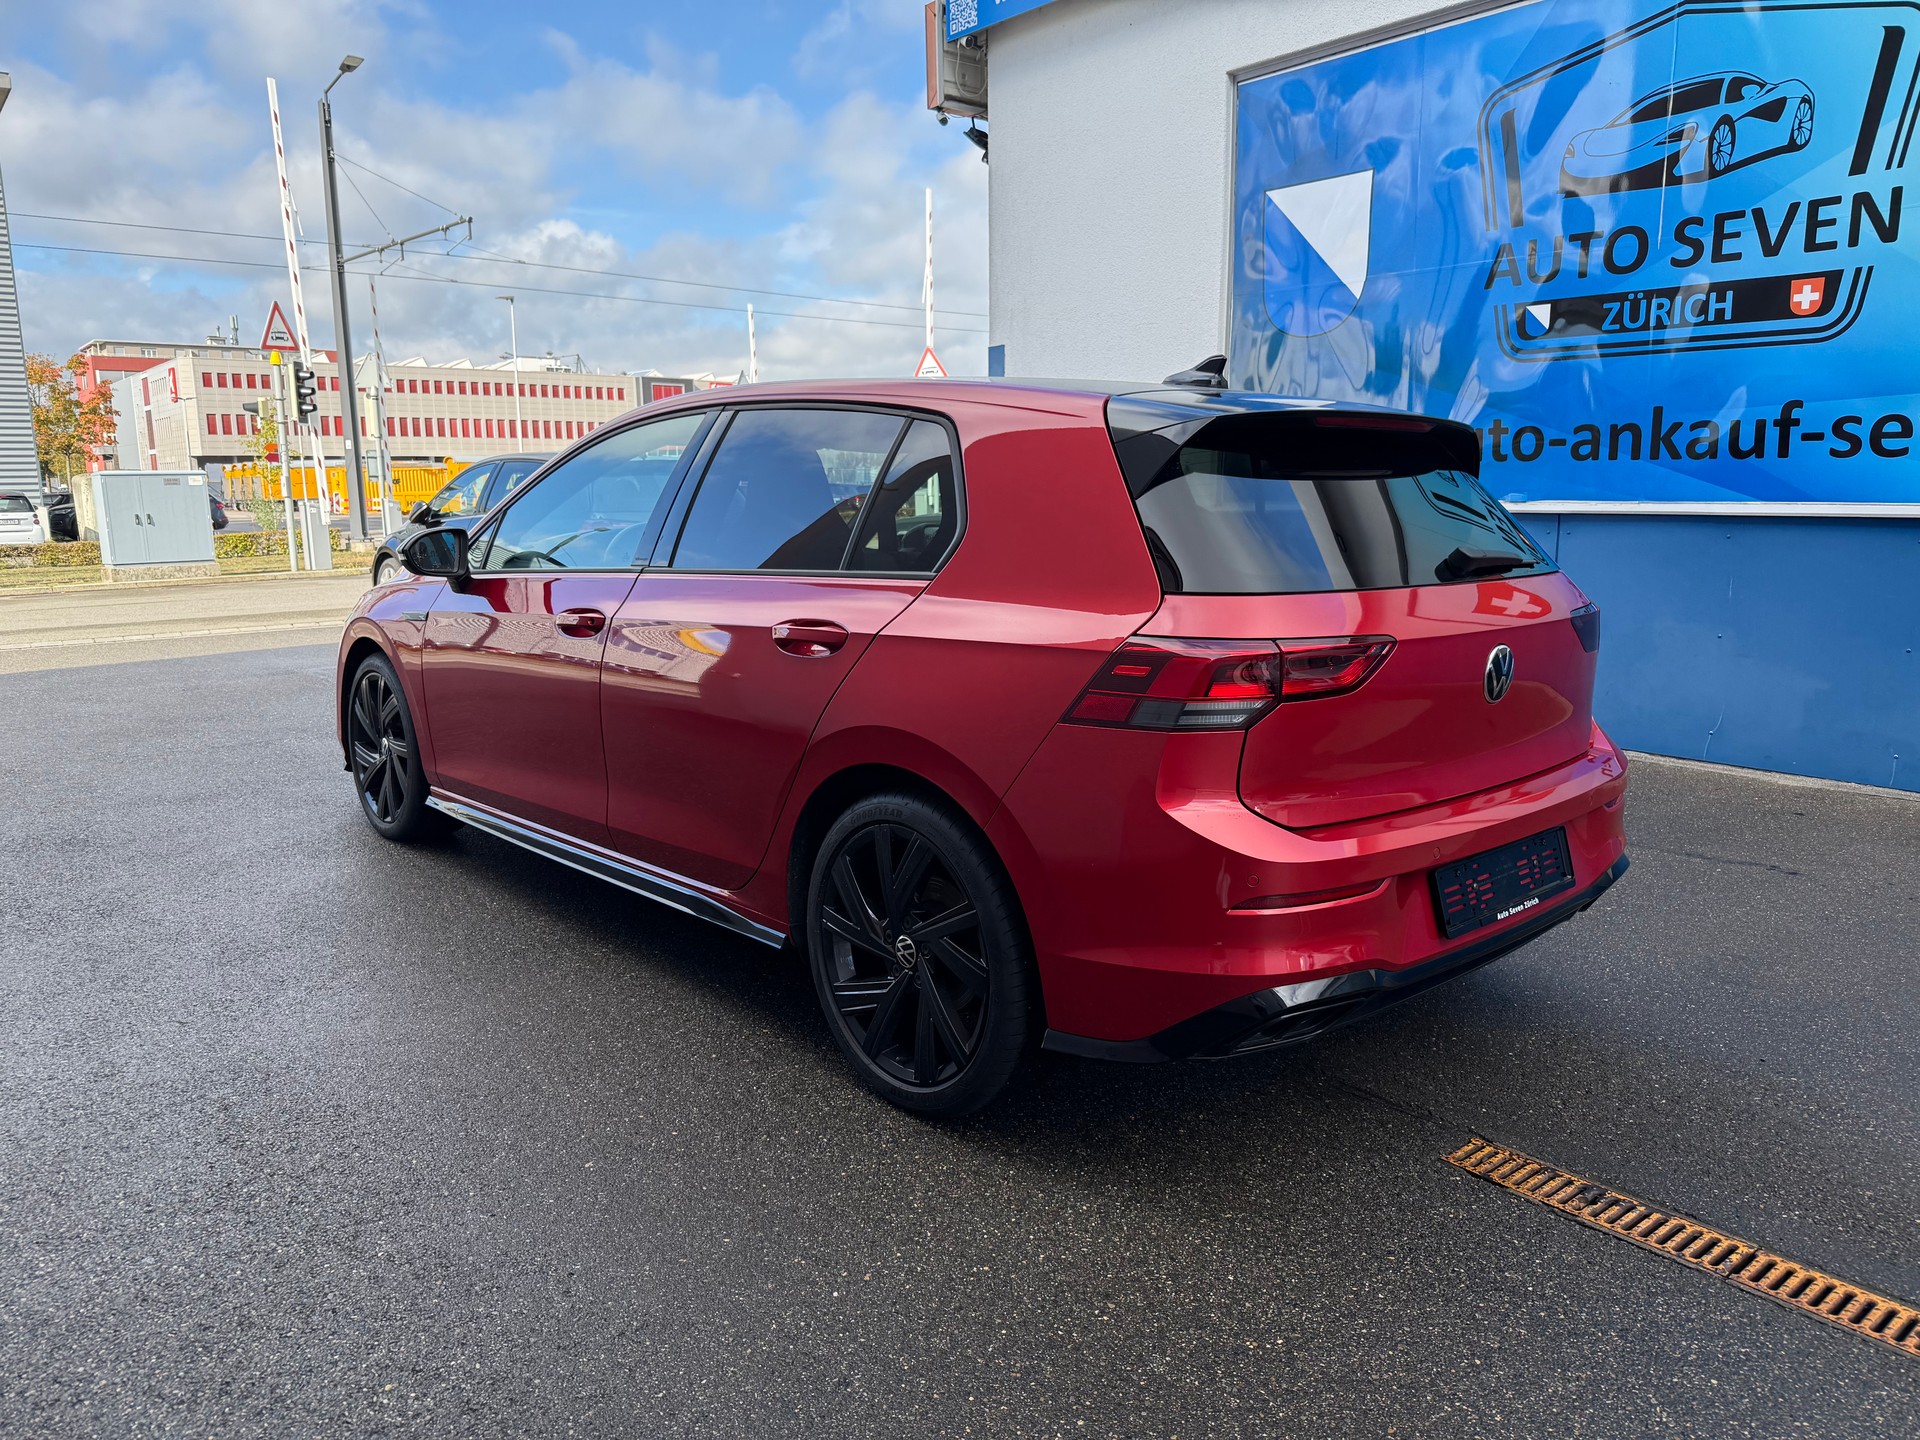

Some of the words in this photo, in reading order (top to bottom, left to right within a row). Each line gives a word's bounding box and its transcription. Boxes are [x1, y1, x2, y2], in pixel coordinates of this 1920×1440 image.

[1483, 225, 1650, 291] AUTO
[1669, 185, 1904, 269] SEVEN
[1601, 290, 1734, 331] ZÜRICH
[1497, 910, 1509, 920] Auto
[1509, 904, 1524, 914] Seven
[1524, 897, 1539, 908] Zürich
